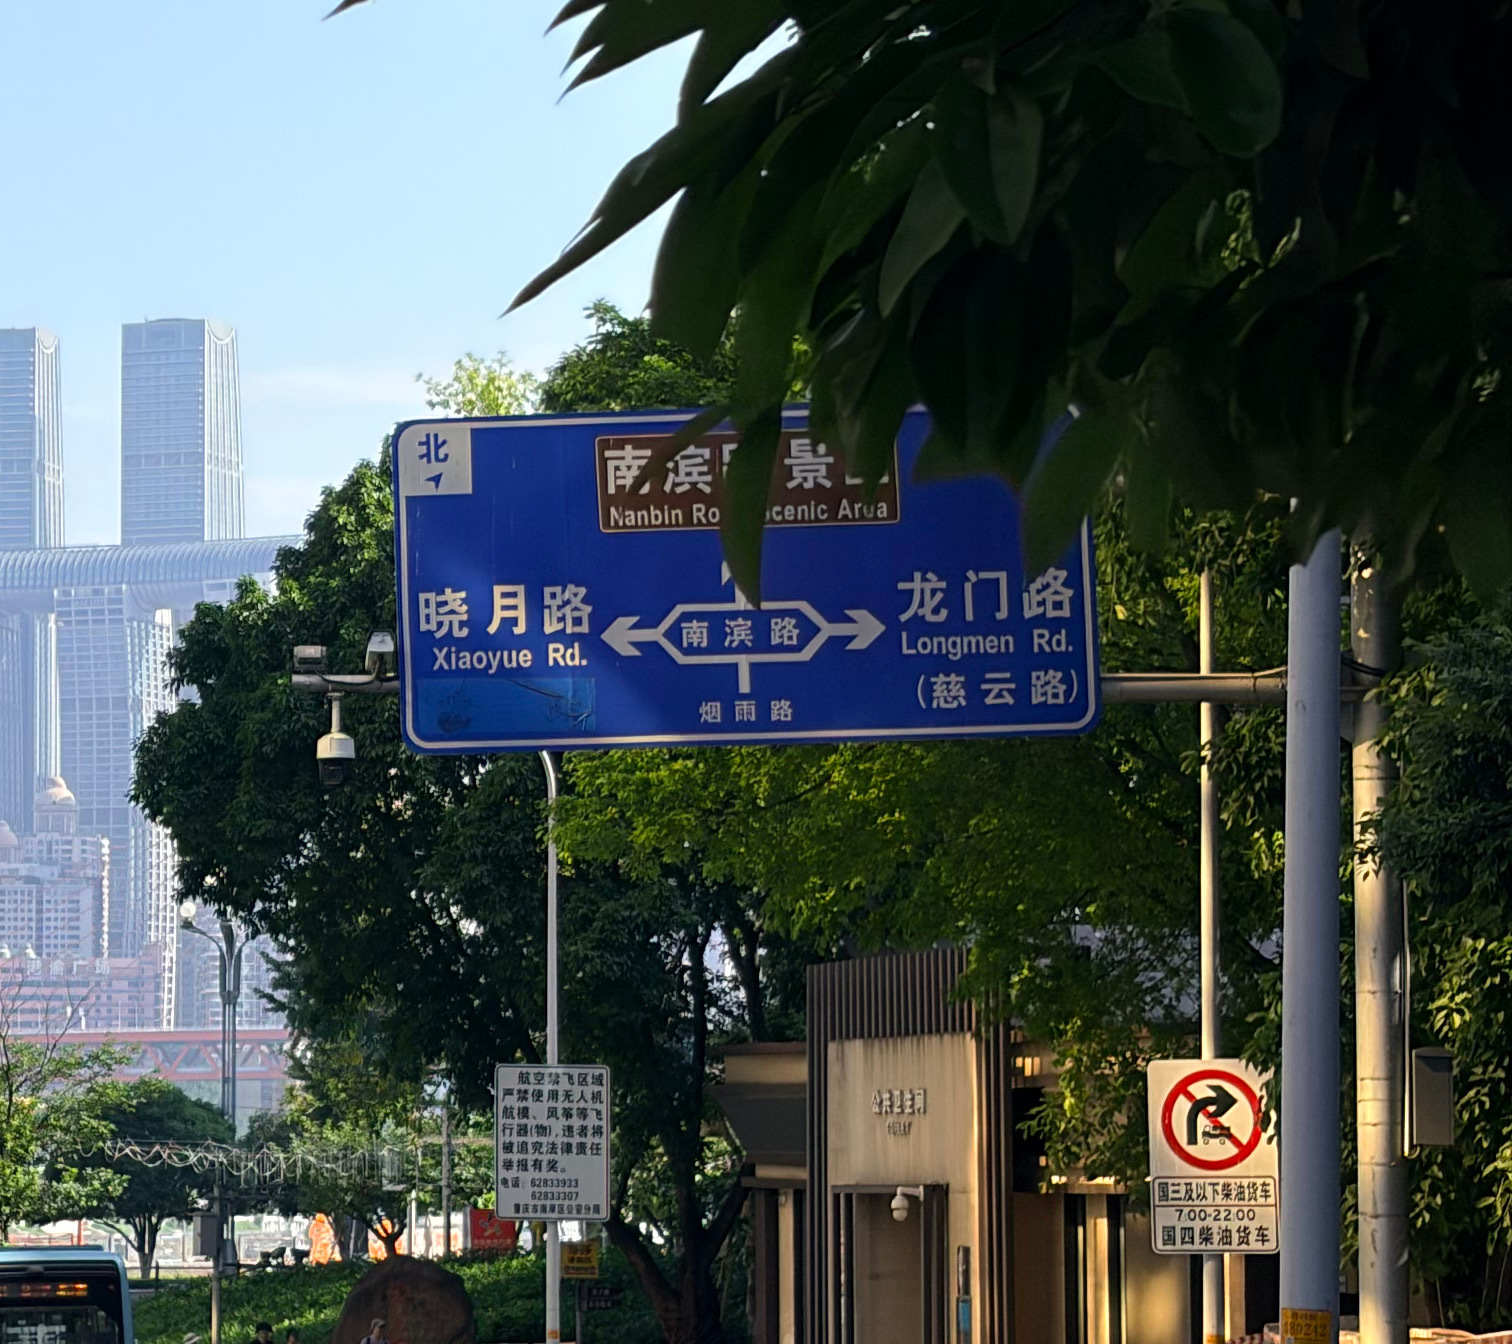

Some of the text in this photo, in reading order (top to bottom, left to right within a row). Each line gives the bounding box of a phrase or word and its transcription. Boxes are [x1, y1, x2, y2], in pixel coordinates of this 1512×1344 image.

[418, 432, 449, 464] 北
[604, 439, 889, 494] 南滨景
[609, 504, 683, 527] Nanbin
[765, 500, 829, 522] cenic
[897, 567, 1074, 623] 龙门路
[418, 583, 593, 639] 晓月路
[681, 617, 800, 648] 南滨路
[901, 628, 1074, 660] Longmen Rd.
[432, 642, 587, 674] Xiaoyue Rd.
[917, 669, 1078, 709] (慈云路)
[699, 699, 793, 723] 烟雨路
[502, 1088, 604, 1104] 严禁使用无人机
[502, 1140, 602, 1156] 被追究法律责任
[1158, 1181, 1272, 1203] 国三及以下柴油货车
[1161, 1226, 1271, 1246] 国四柴油货车
